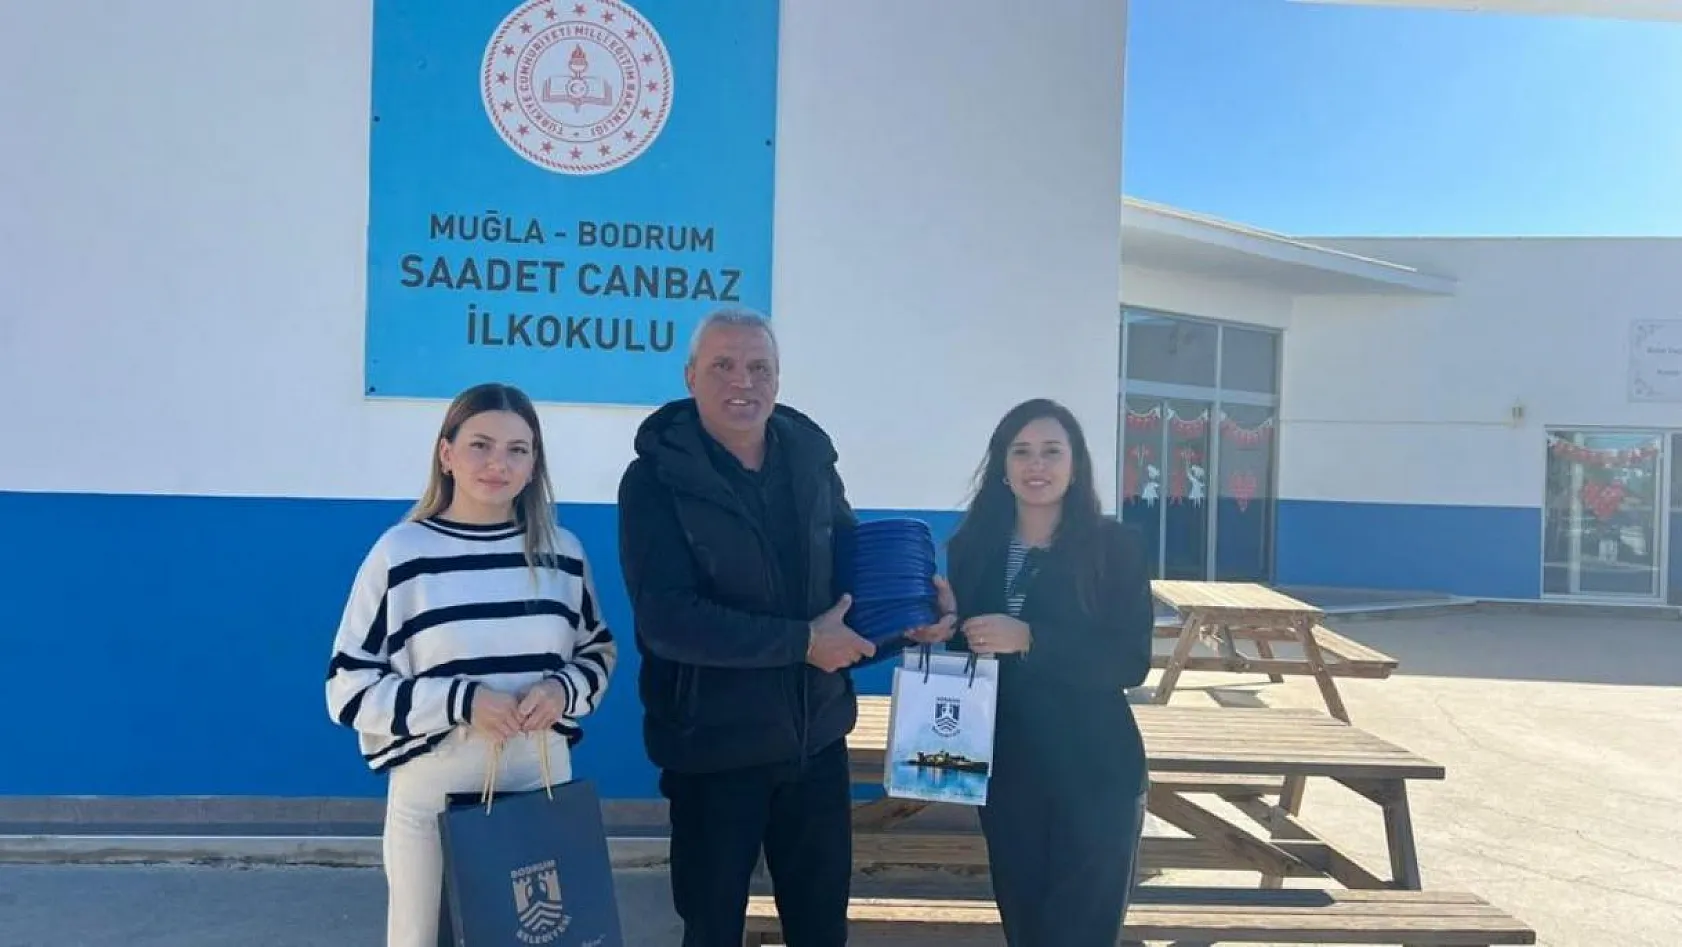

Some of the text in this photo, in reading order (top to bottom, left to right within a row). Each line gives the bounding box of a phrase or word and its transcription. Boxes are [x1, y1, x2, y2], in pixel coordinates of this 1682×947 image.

[429, 209, 544, 244] MUĞLA
[578, 221, 715, 252] BODRUM
[400, 254, 742, 302] SAADET CANBAZ
[467, 303, 675, 353] İLKOKULU
[510, 859, 556, 879] BODRUM
